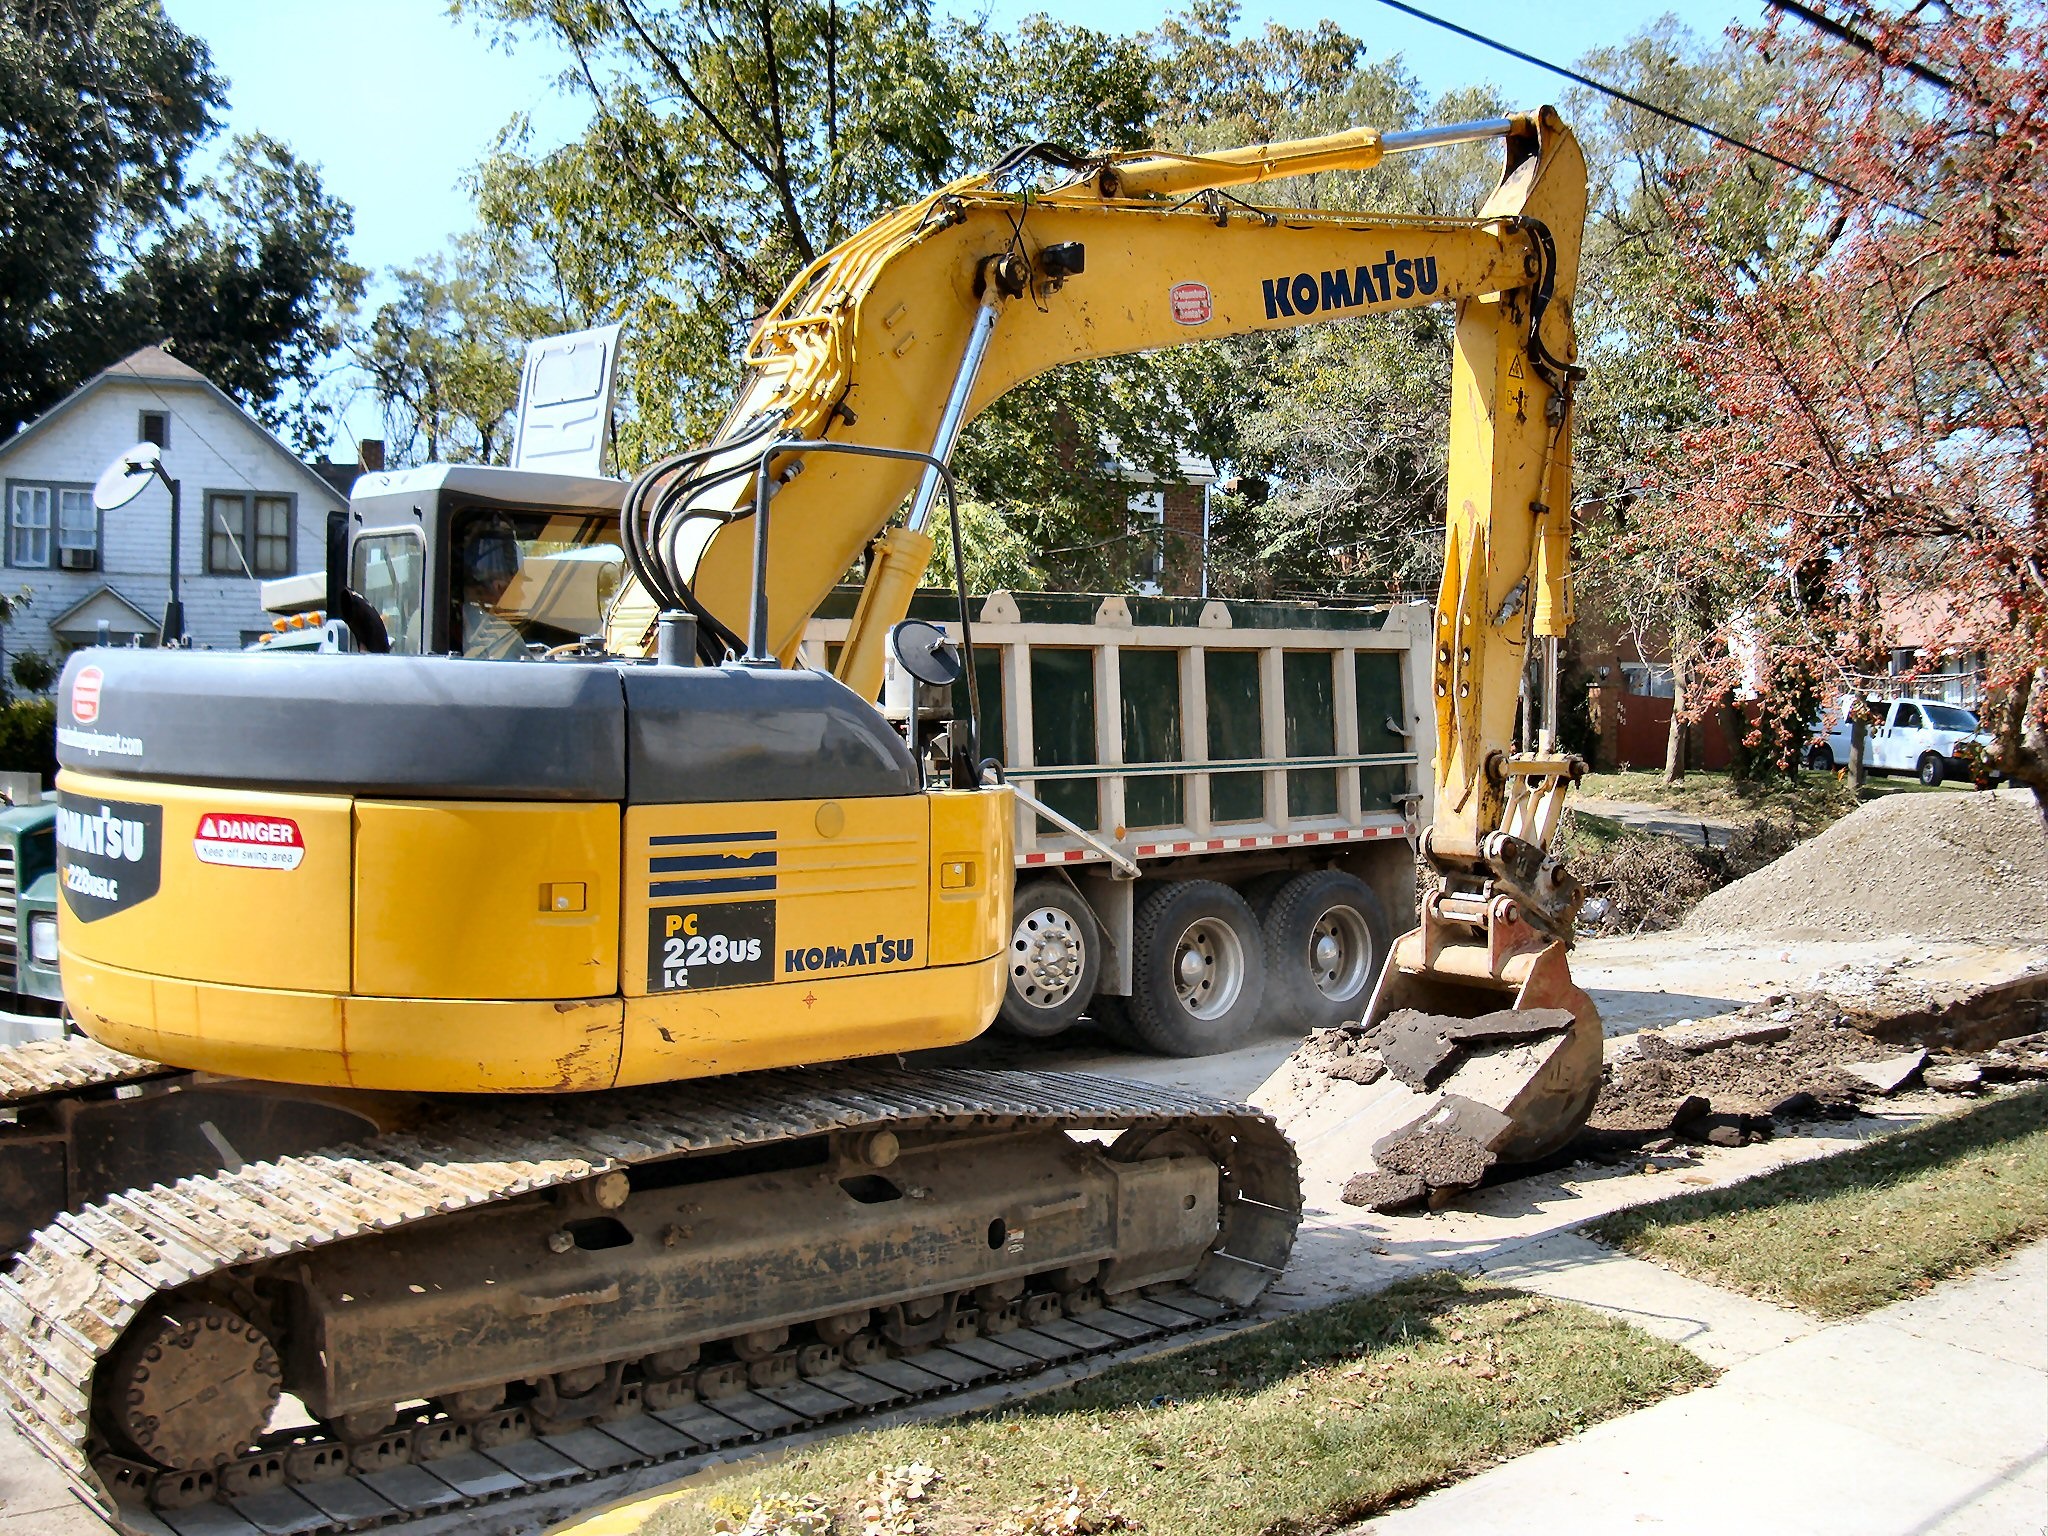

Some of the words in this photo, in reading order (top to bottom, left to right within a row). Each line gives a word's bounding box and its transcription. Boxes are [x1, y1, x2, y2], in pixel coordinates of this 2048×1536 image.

[1262, 250, 1438, 320] KOMATSU
[57, 805, 144, 862] OMATSU
[218, 819, 293, 844] DANGER
[242, 850, 268, 864] swing
[271, 853, 293, 863] area
[665, 913, 698, 938] PC
[662, 934, 762, 969] 228US
[785, 934, 914, 973] KOMATSU
[664, 968, 688, 988] LC
